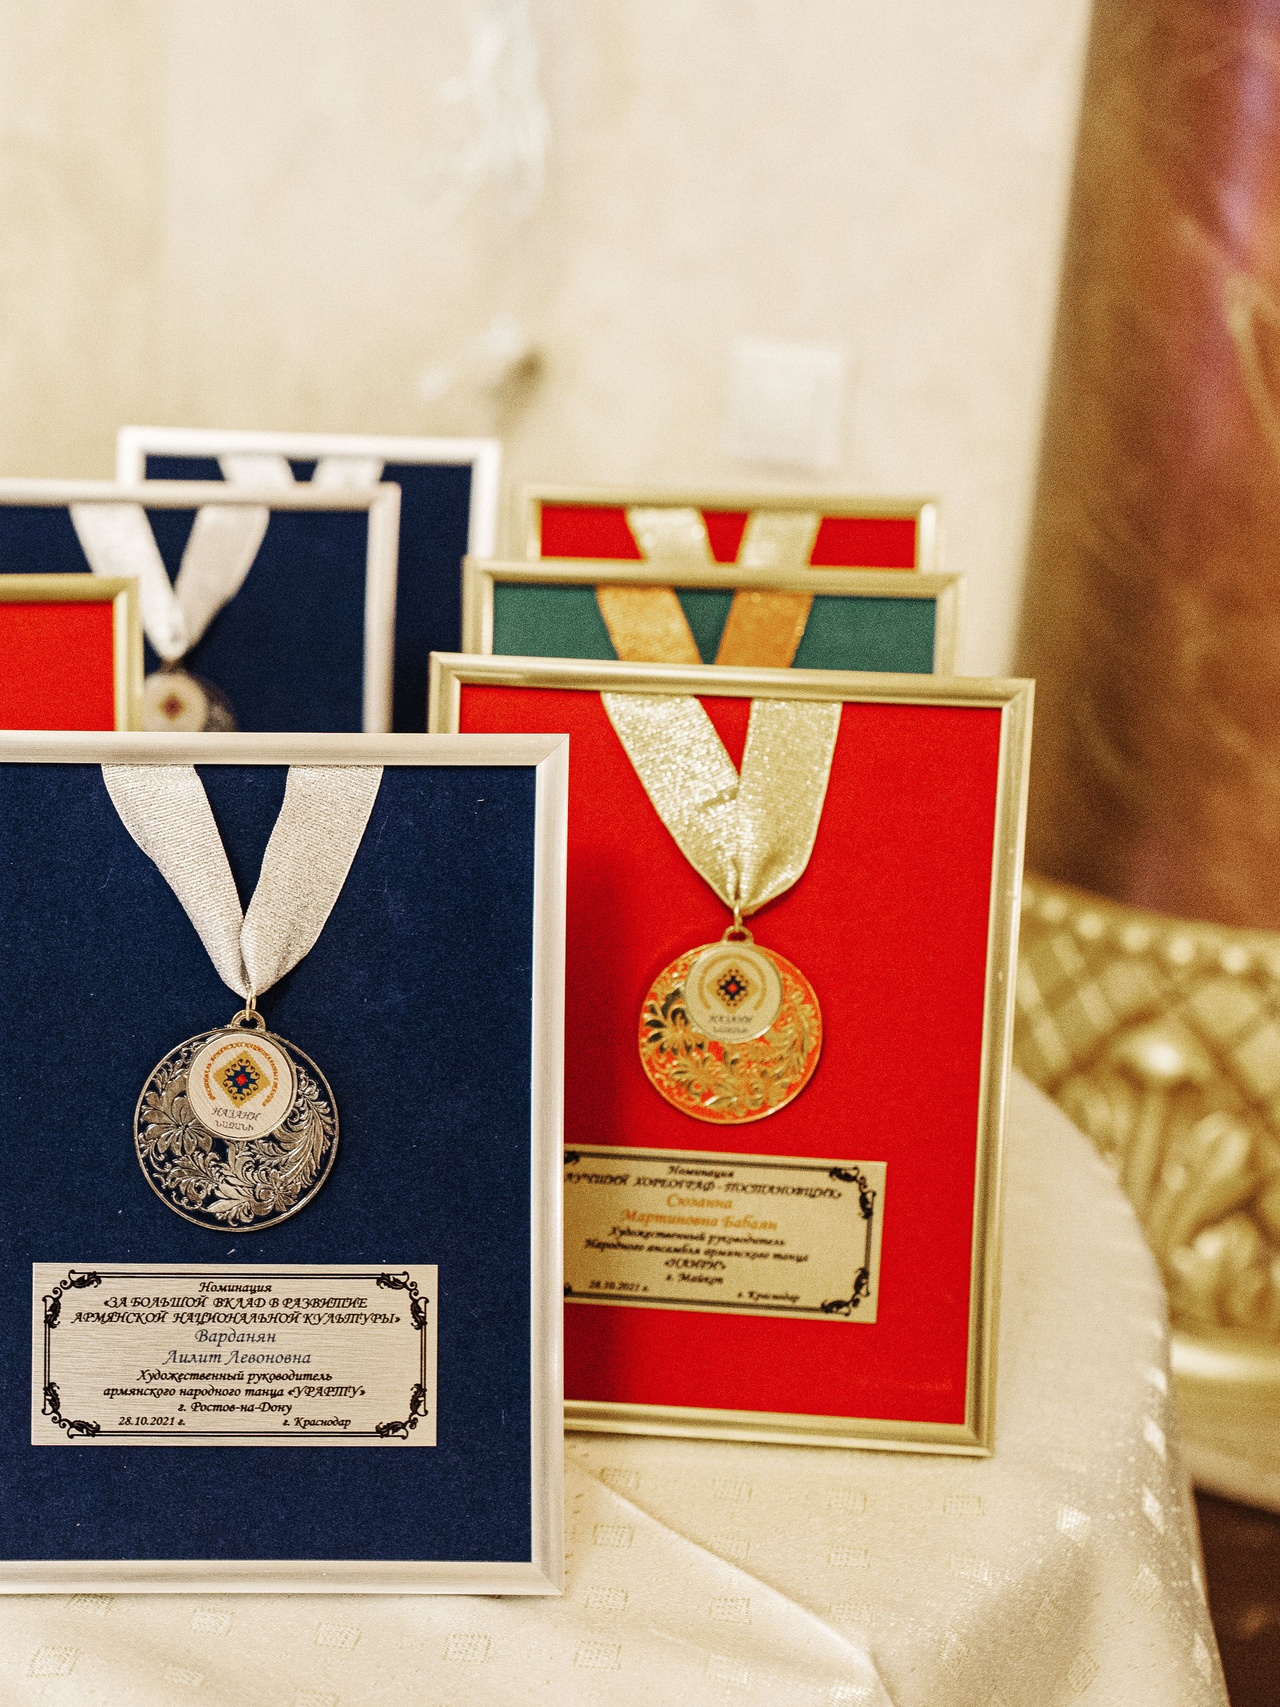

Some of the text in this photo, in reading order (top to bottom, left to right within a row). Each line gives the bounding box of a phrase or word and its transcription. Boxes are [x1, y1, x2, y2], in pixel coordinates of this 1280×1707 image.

[211, 1107, 262, 1121] НАЗАНИ
[198, 1281, 273, 1294] Номинация
[103, 1295, 368, 1309] «ЗА БОЛЬШОЙ ВКЛАД В РАЗВИТИЕ
[70, 1310, 401, 1325] АРМЯНСКОЙ НАЦИОНАЛЬНОЙ КУЛЬТУРЫ»
[194, 1327, 277, 1345] Варданян
[162, 1350, 312, 1365] Лилит Левоновна
[136, 1368, 333, 1384] Художественный руководитель
[103, 1384, 367, 1399] армянского народного танца «УРАРТУ»
[177, 1401, 293, 1416] г. Ростов-на-Дону
[118, 1416, 176, 1427] 28.10.2021
[293, 1416, 352, 1429] Краснодар
